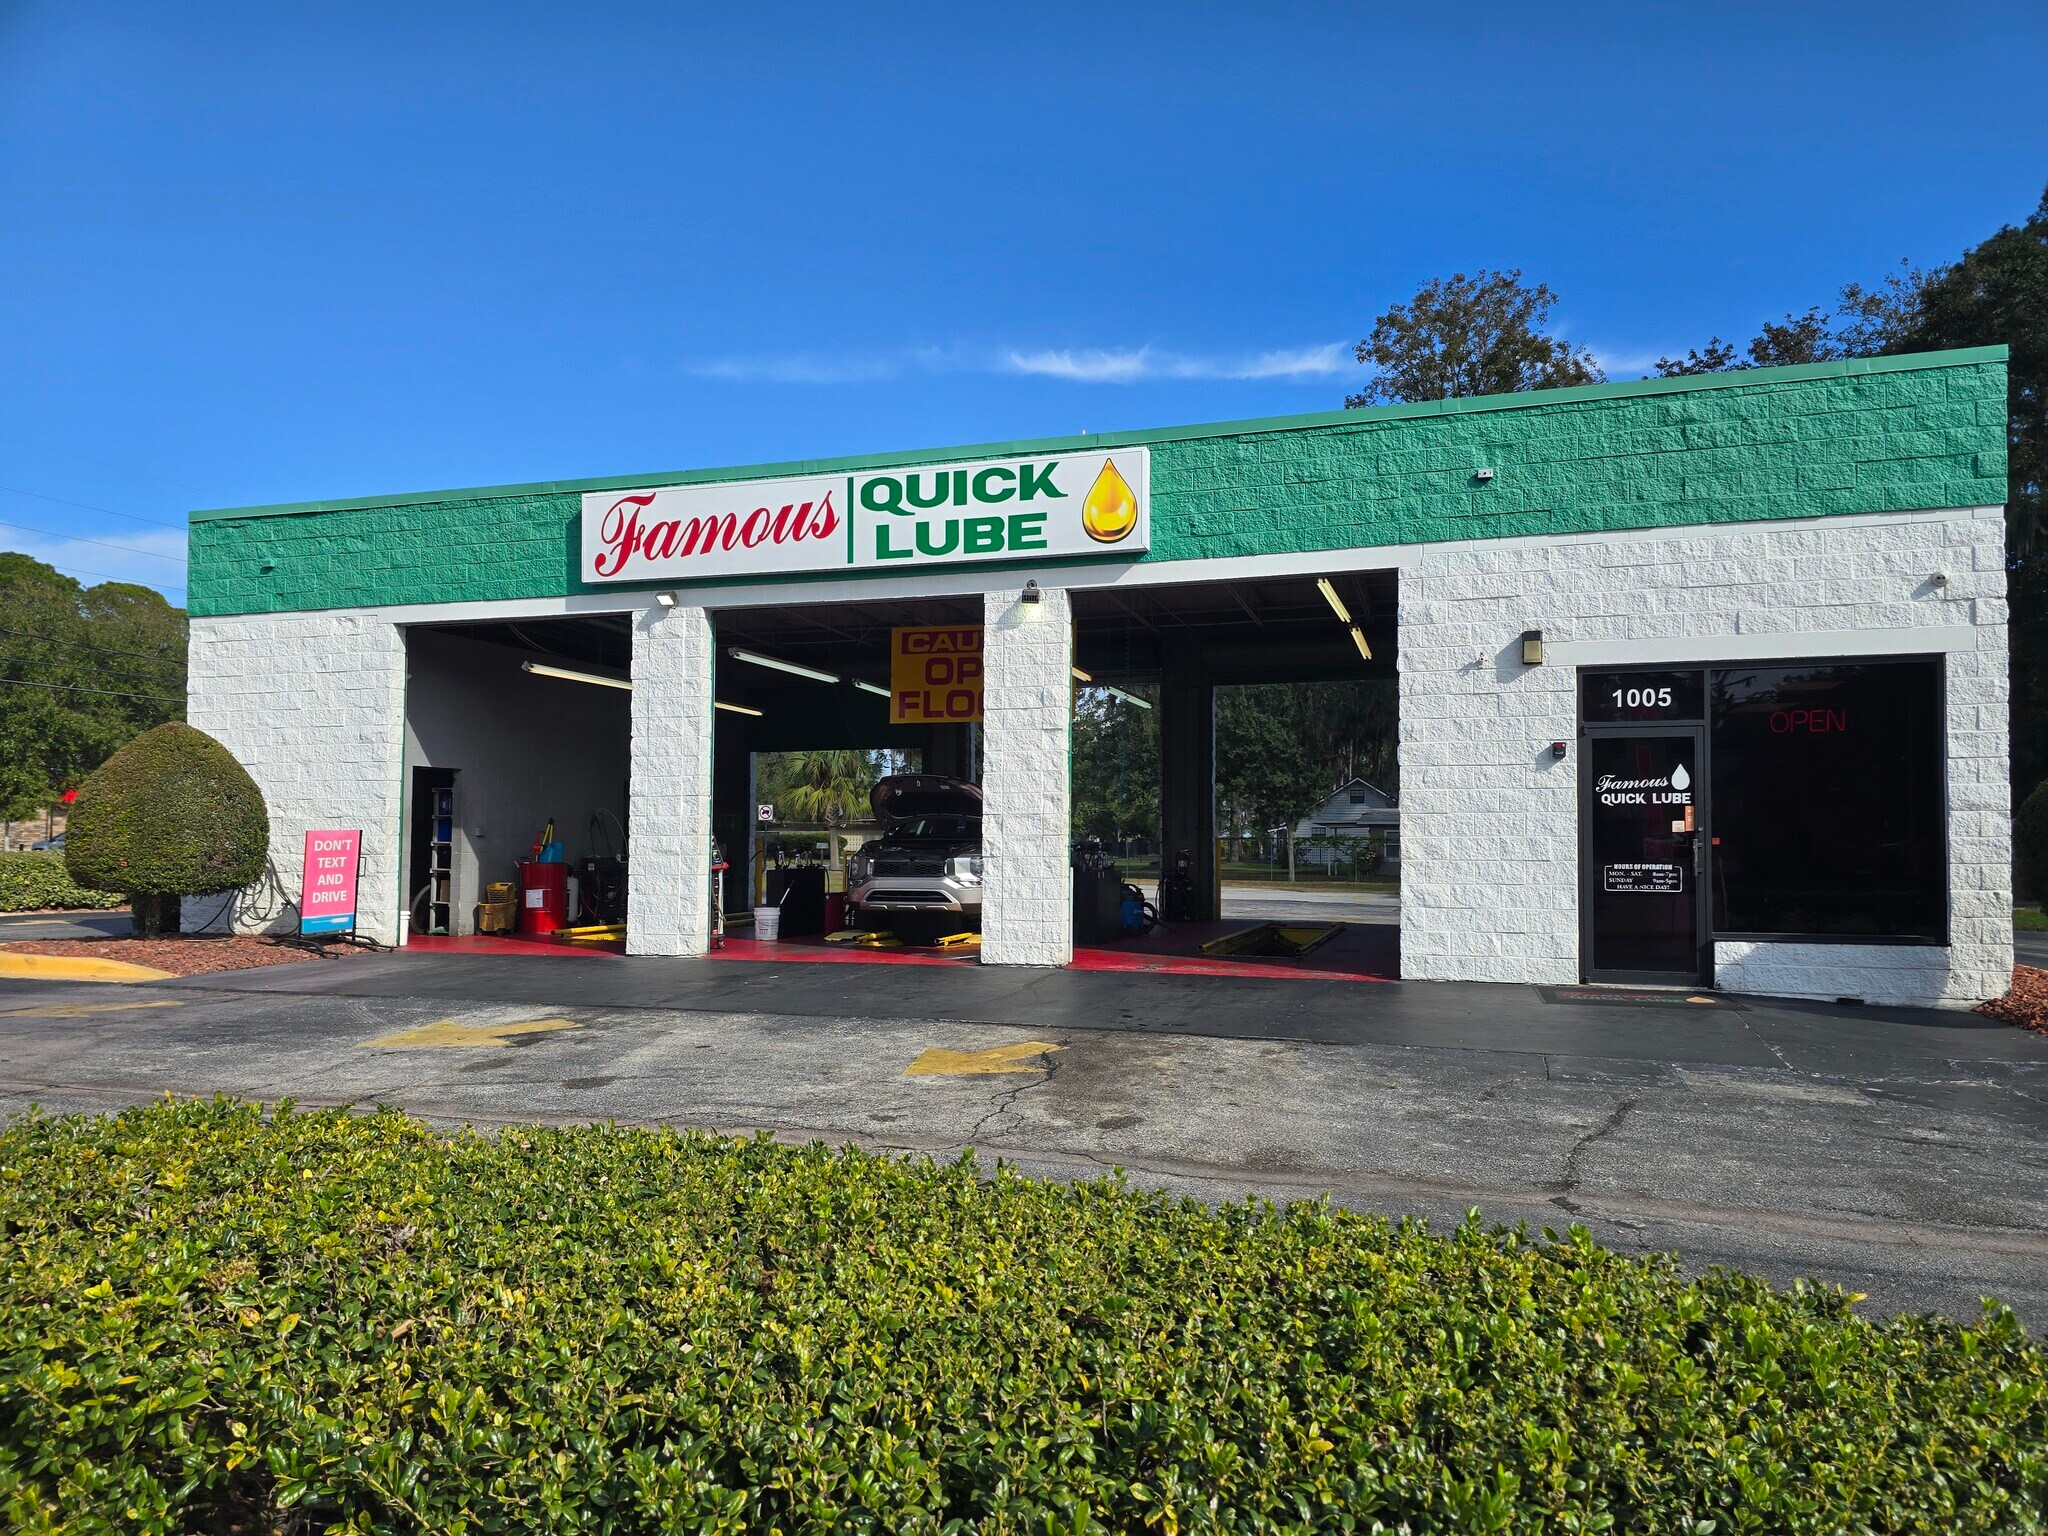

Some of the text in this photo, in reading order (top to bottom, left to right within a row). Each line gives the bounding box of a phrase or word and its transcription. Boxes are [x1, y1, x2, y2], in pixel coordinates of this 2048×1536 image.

[860, 461, 1069, 516] QUICK
[594, 490, 840, 577] Famous
[876, 512, 1048, 560] LUBE
[908, 632, 984, 652] CAU
[898, 689, 984, 718] FLO
[1612, 687, 1672, 708] 1005
[1769, 708, 1846, 734] OPEN
[1596, 774, 1669, 792] Famous
[1601, 792, 1691, 806] QUICK LUBE
[314, 839, 352, 852] DON'T
[317, 856, 347, 869] TEXT
[317, 873, 344, 886] AND
[312, 890, 348, 904] DRIVE
